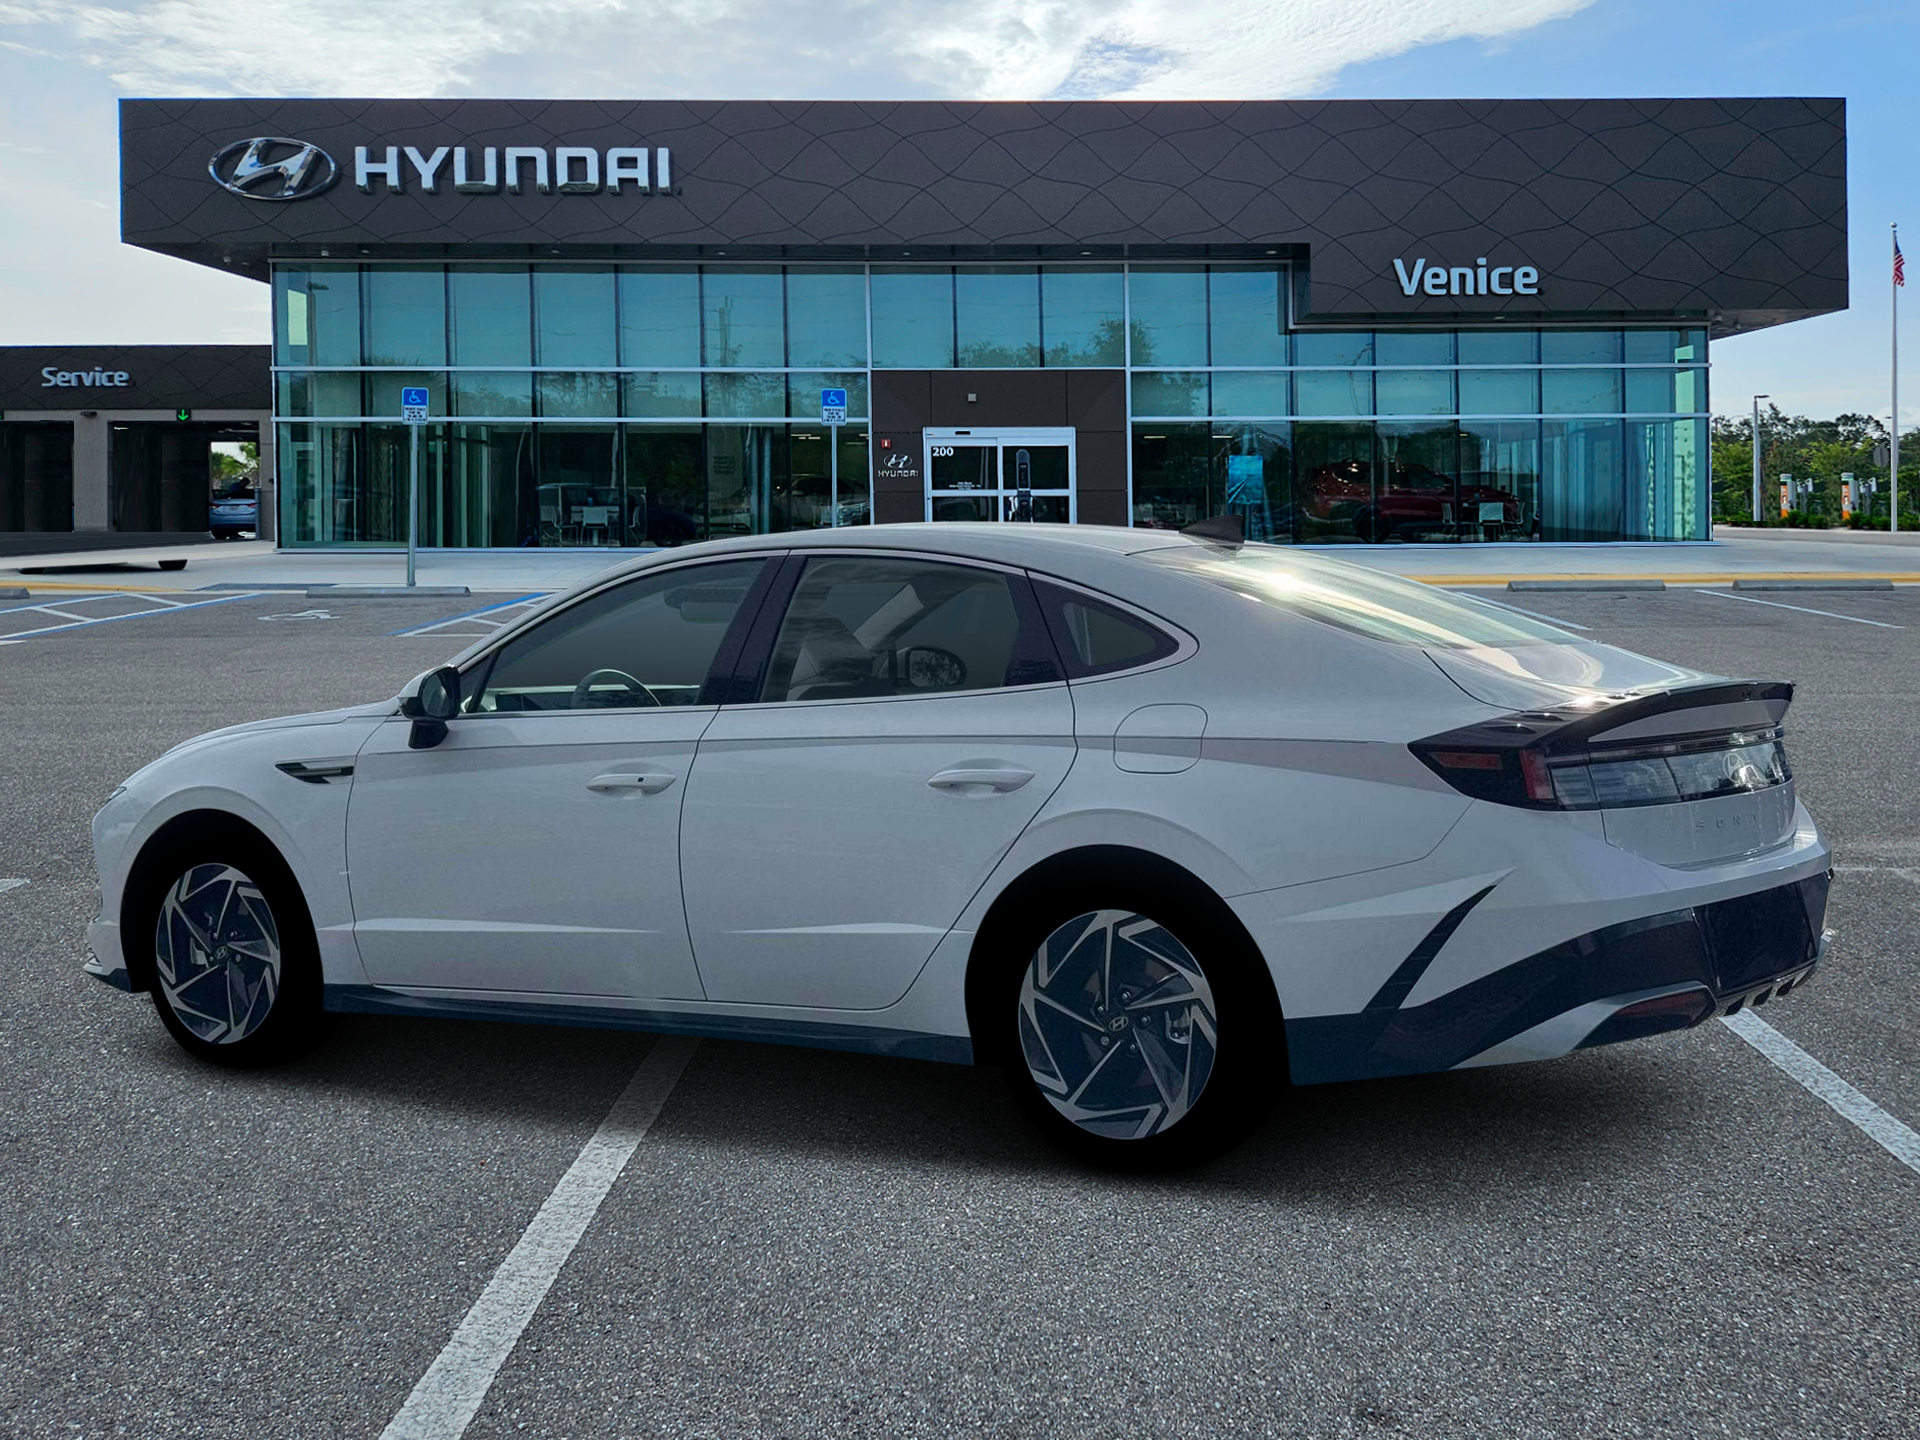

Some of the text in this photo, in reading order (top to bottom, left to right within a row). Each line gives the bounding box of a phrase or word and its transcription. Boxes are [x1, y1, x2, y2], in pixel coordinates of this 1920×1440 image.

[354, 146, 671, 195] HYUNDAI
[1392, 256, 1539, 296] Venice
[41, 366, 130, 387] Service
[932, 446, 954, 457] 200
[877, 469, 919, 478] HYUNDAI
